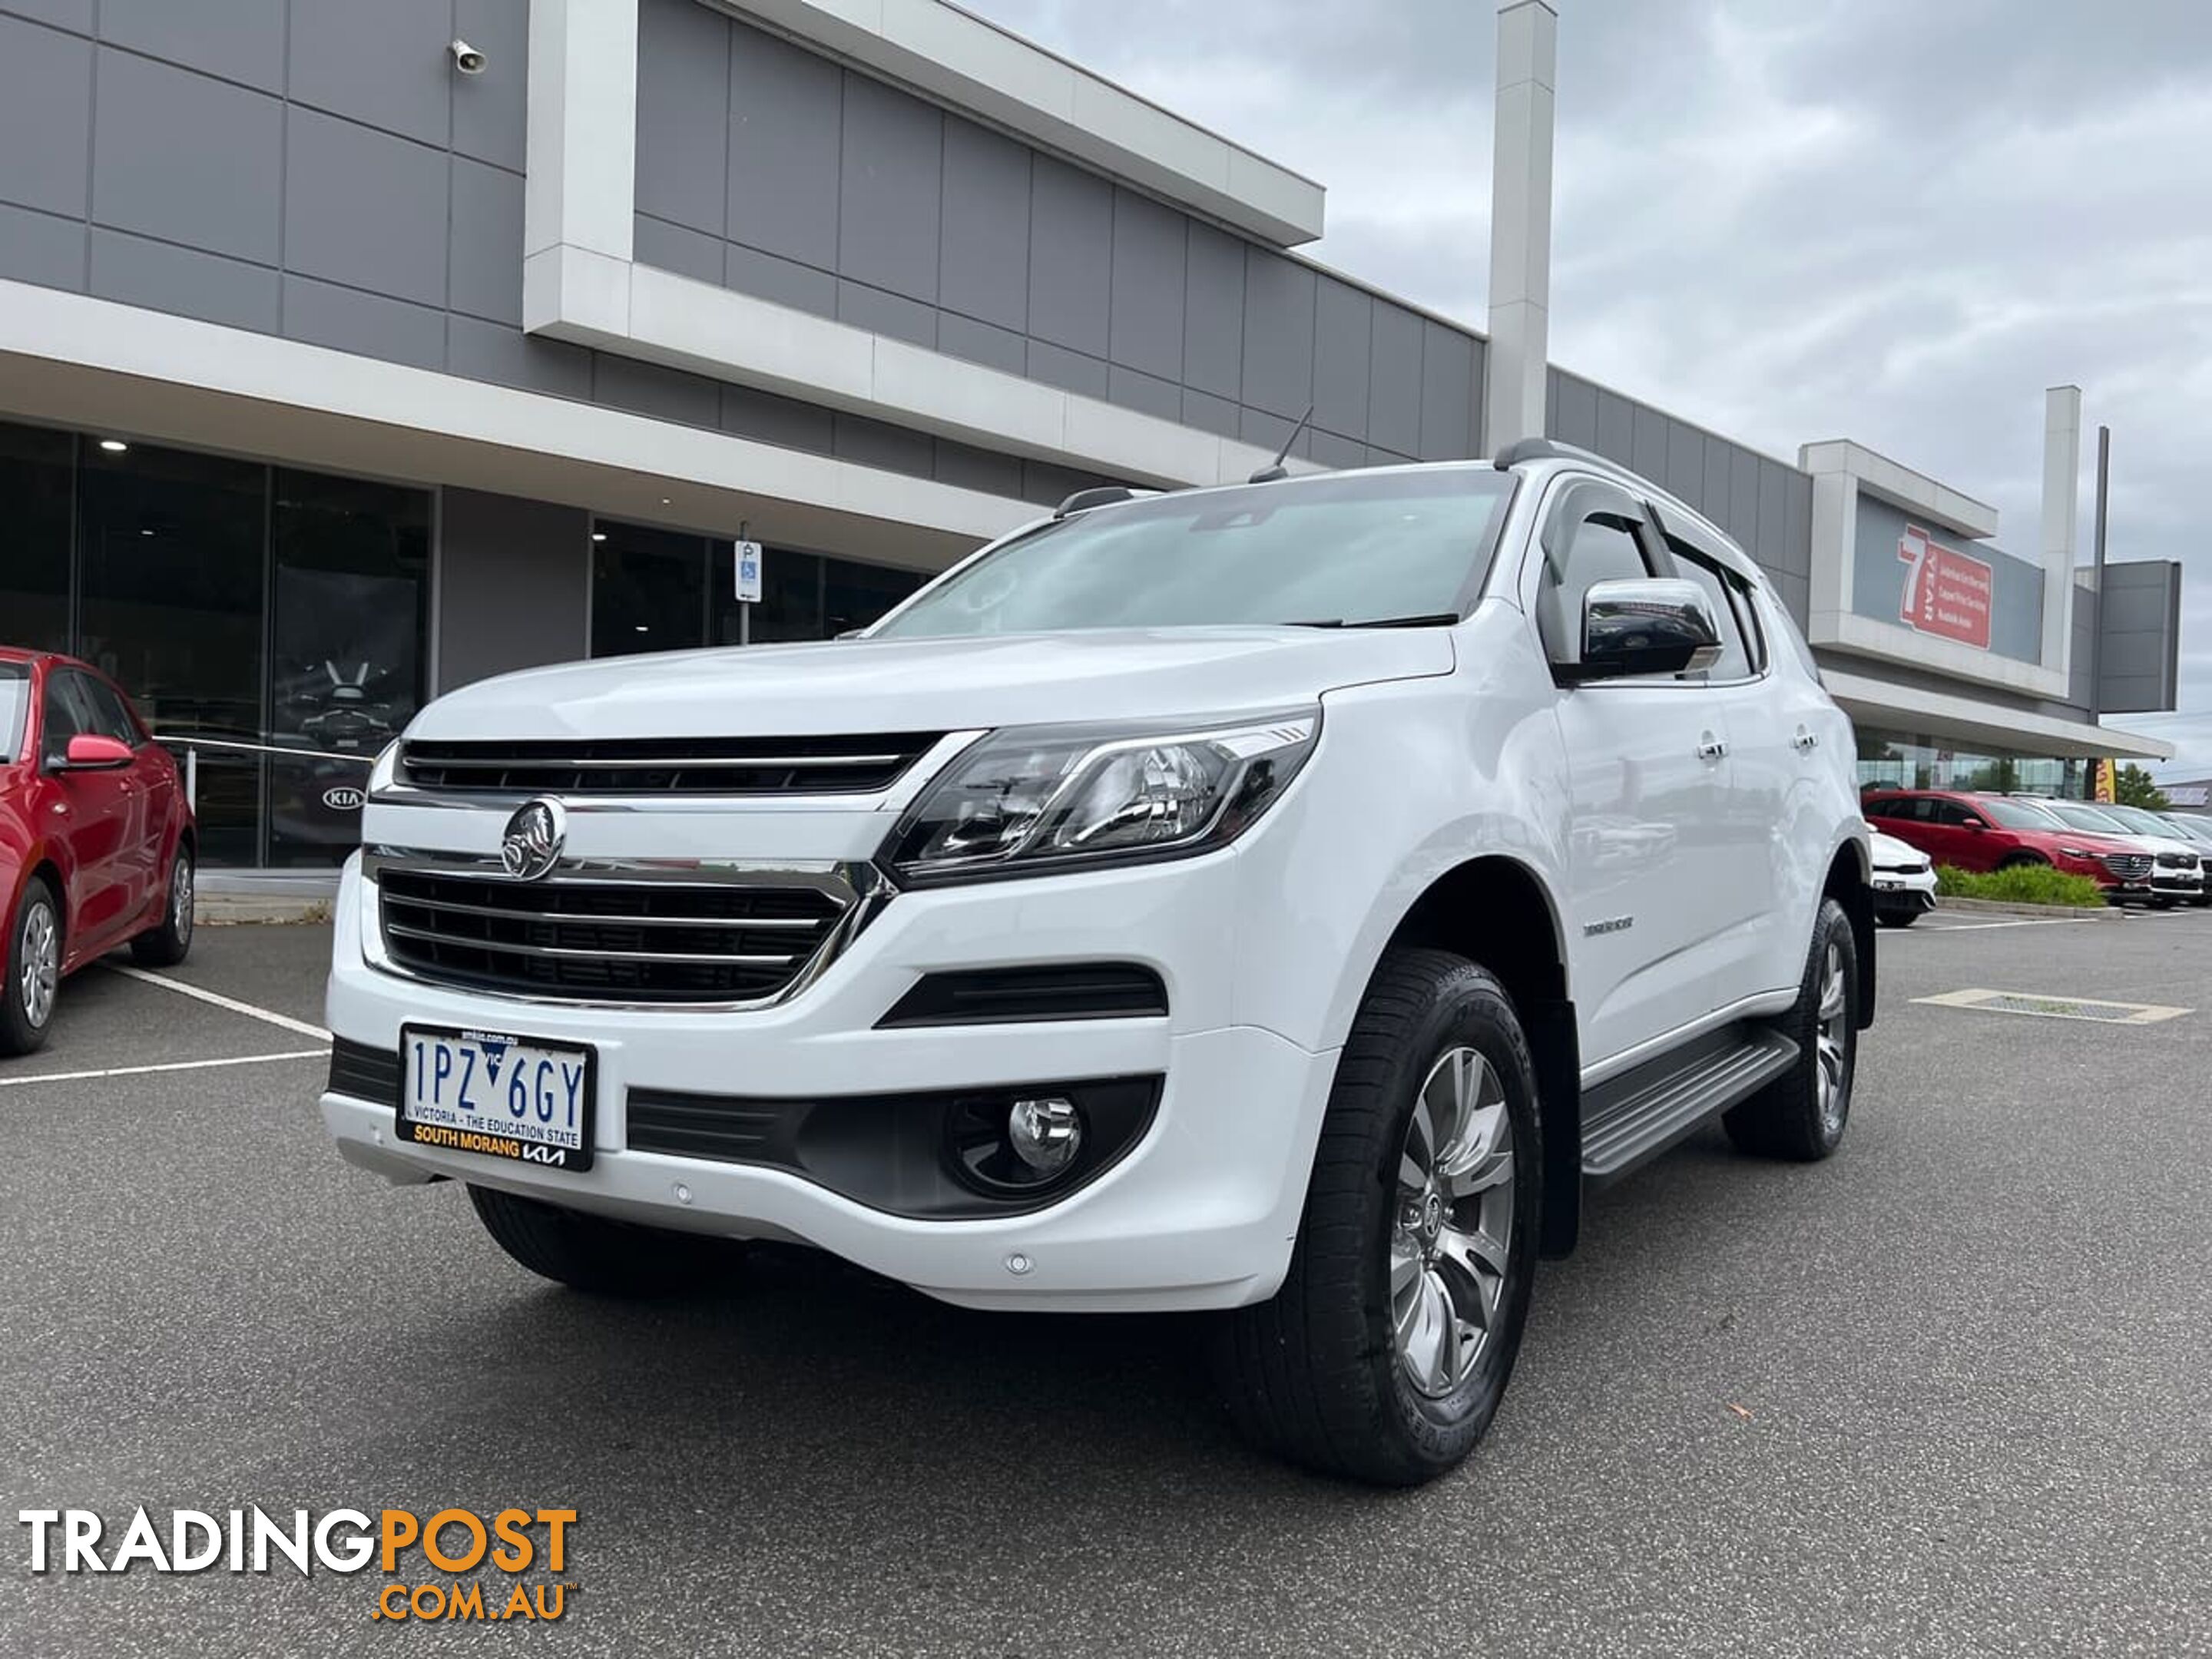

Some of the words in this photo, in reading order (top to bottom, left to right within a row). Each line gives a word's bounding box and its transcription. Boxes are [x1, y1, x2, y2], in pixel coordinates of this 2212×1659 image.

[1901, 528, 1927, 614] 7
[1924, 552, 1938, 621] YEAR
[330, 793, 359, 805] KIA
[415, 1041, 475, 1111] 1PZ
[508, 1058, 583, 1128] 6GY
[414, 1124, 458, 1147] SOUTH
[460, 1132, 520, 1157] MORANG
[415, 1106, 456, 1124] VICTORIA
[466, 1117, 485, 1131] THE
[487, 1119, 544, 1140] EDUCATION
[547, 1129, 578, 1147] STATE
